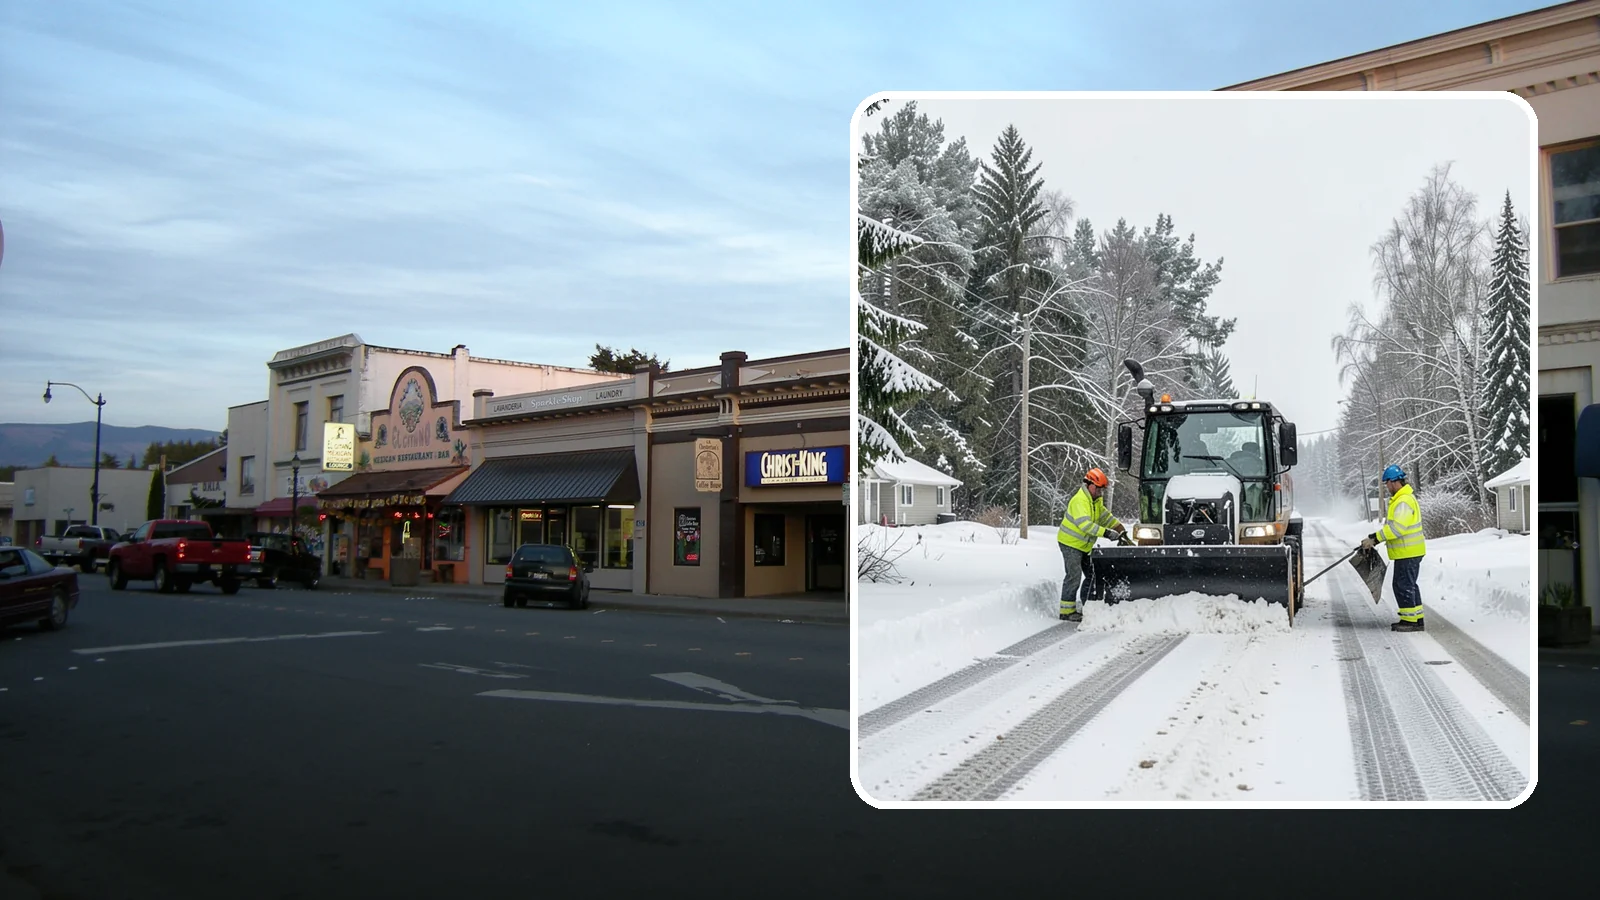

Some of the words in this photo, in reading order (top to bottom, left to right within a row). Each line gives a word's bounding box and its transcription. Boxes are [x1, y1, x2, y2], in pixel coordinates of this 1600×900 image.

[595, 389, 623, 400] LAUNDRY
[493, 402, 522, 413] LAVANDERIA
[531, 397, 561, 409] Sparkle
[562, 394, 582, 404] Shop
[373, 455, 396, 464] MEXICAN
[397, 451, 433, 462] RESTAURANT
[438, 450, 450, 459] BAR
[761, 452, 797, 478] CHRIST
[799, 450, 827, 476] KING
[696, 480, 709, 489] Coffee
